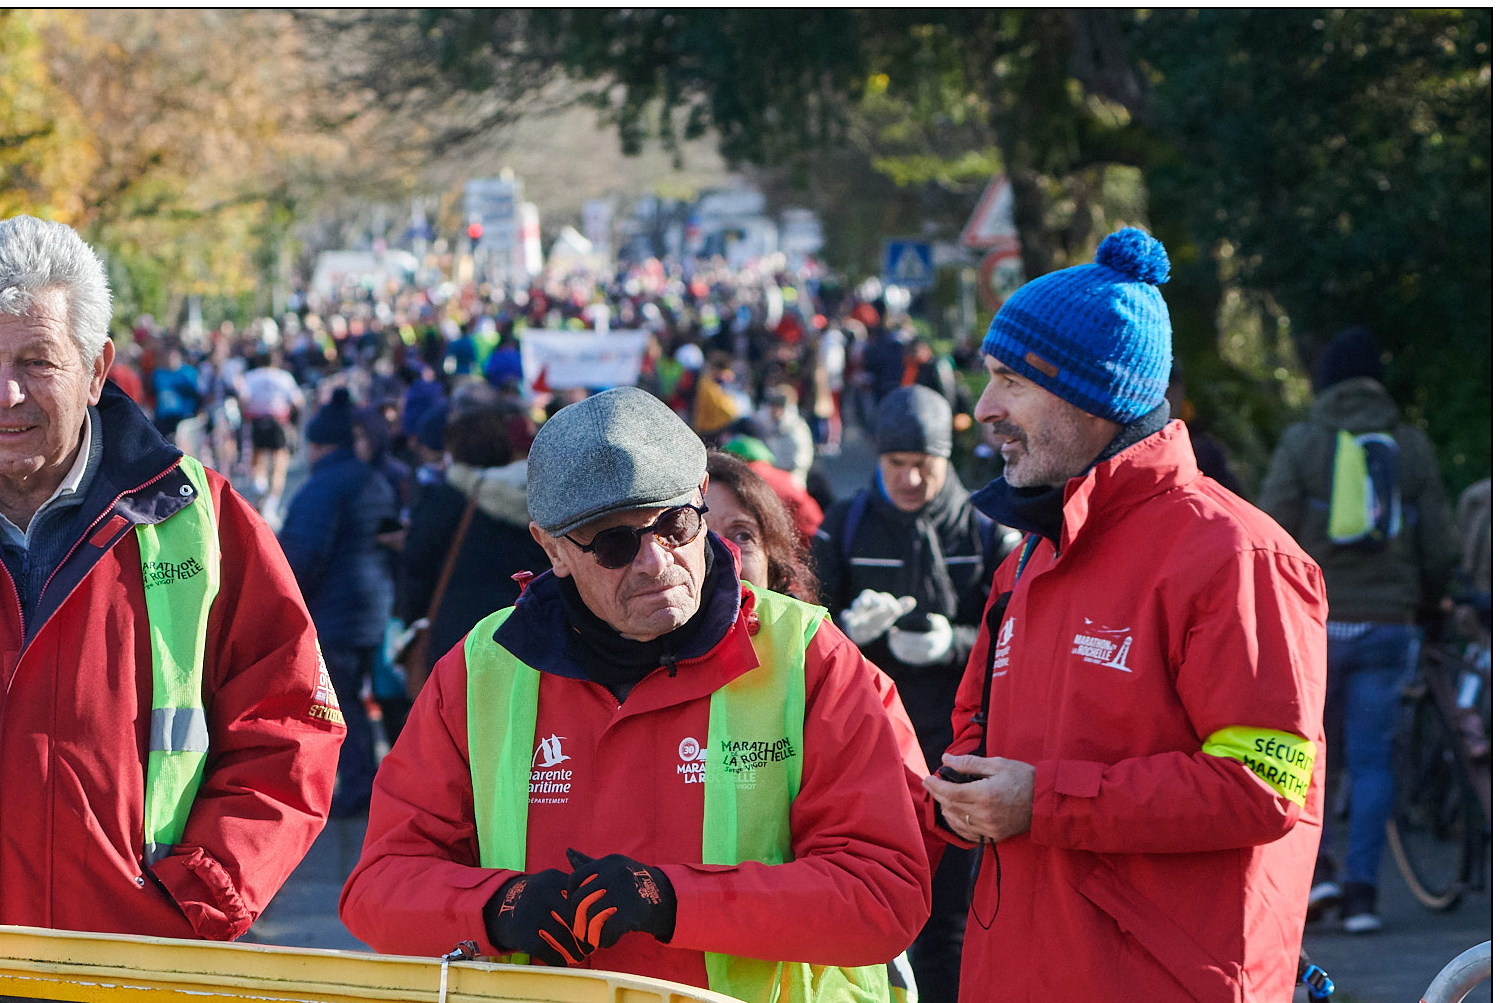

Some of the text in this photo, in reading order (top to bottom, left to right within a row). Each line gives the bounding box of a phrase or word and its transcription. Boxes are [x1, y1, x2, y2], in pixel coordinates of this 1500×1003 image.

[683, 745, 695, 755] 30
[721, 737, 791, 760] MARATHON
[723, 743, 797, 766] LA ROCHELLE
[745, 761, 768, 771] VIGOT
[528, 781, 571, 793] aritime
